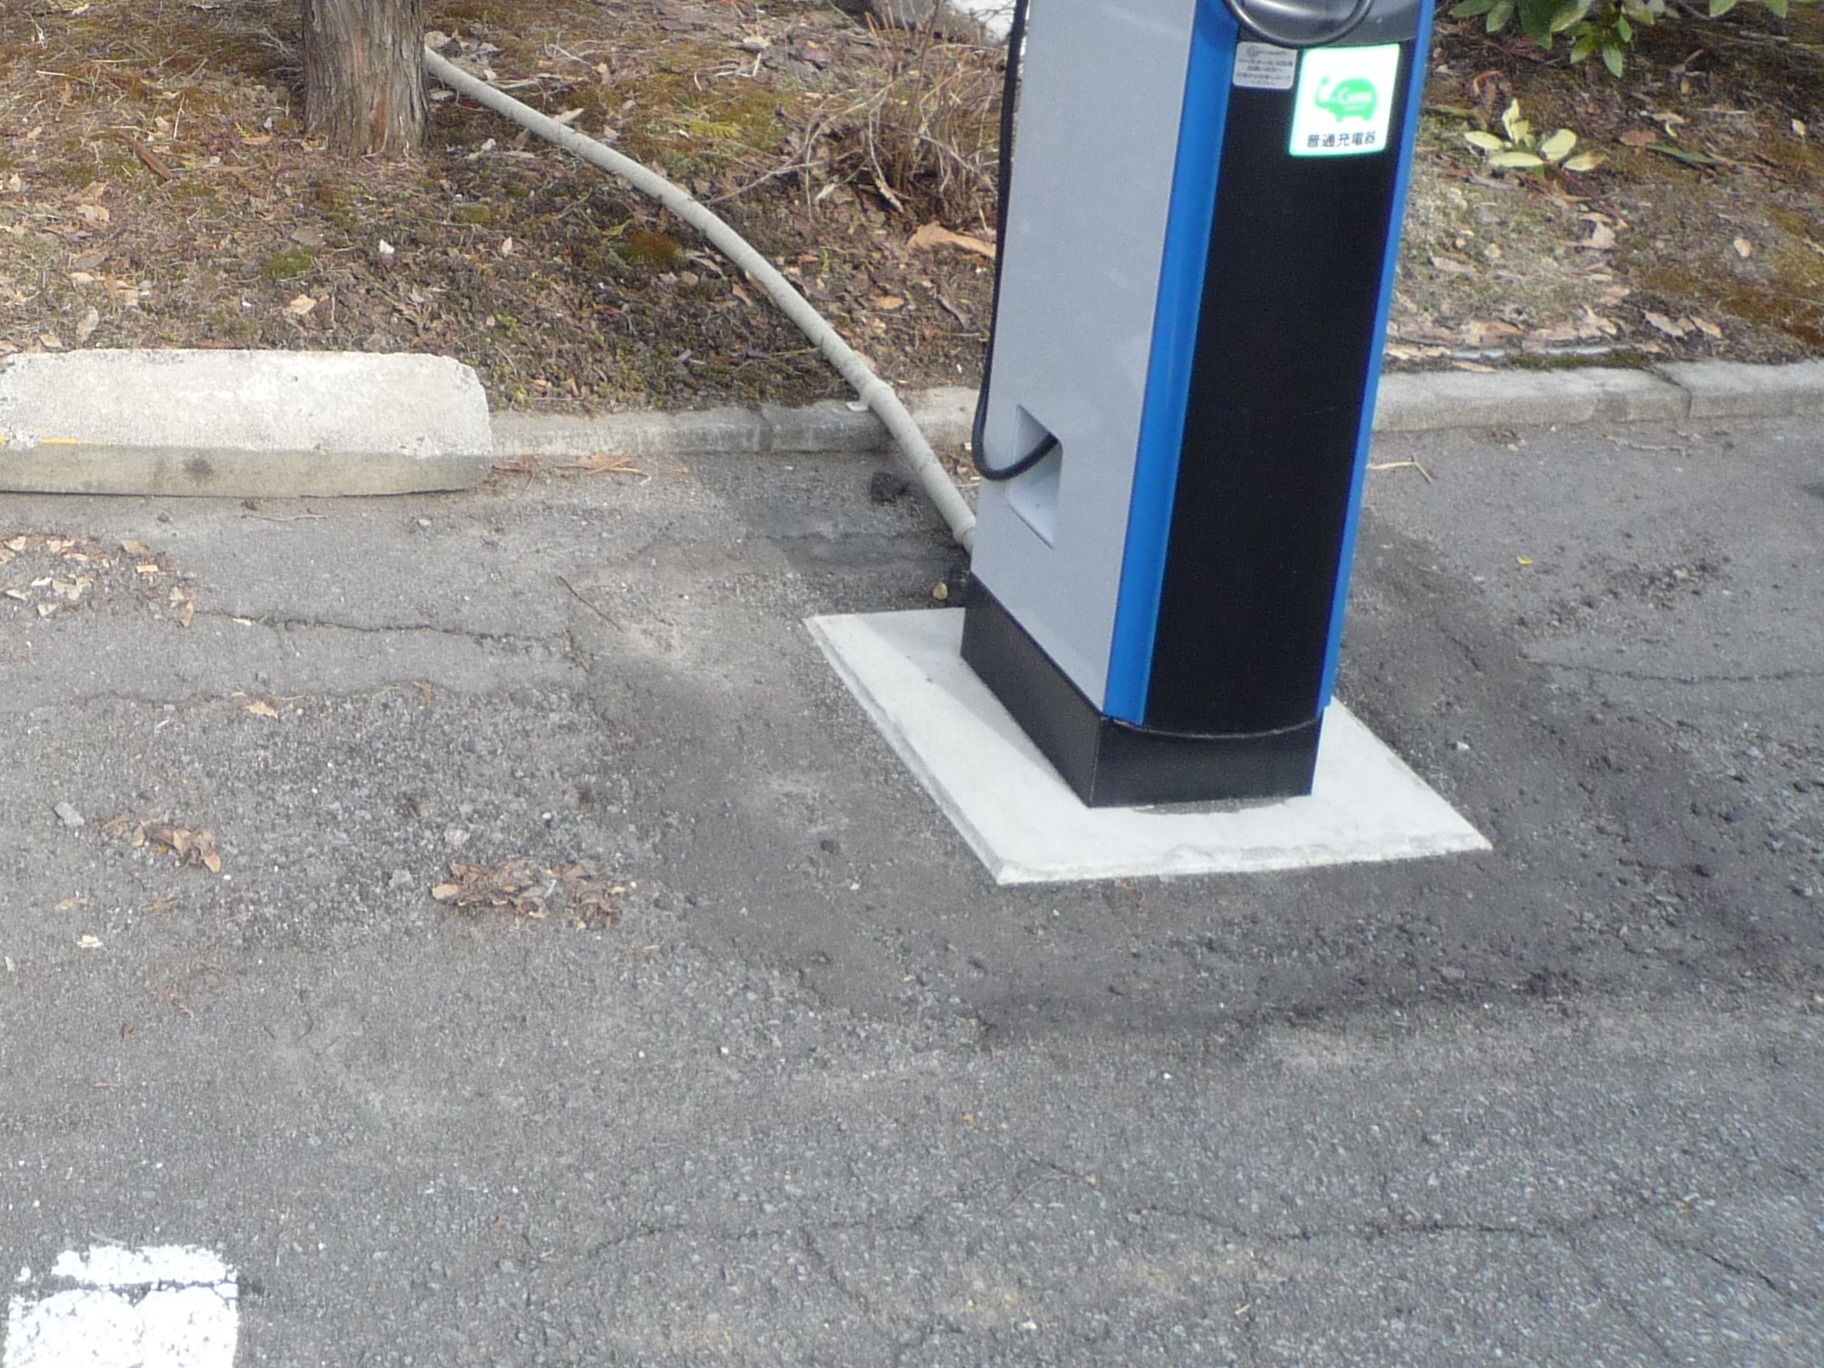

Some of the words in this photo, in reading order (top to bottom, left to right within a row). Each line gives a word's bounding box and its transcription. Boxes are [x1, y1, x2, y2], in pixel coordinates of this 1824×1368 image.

[1307, 131, 1376, 148] 普通充電器
